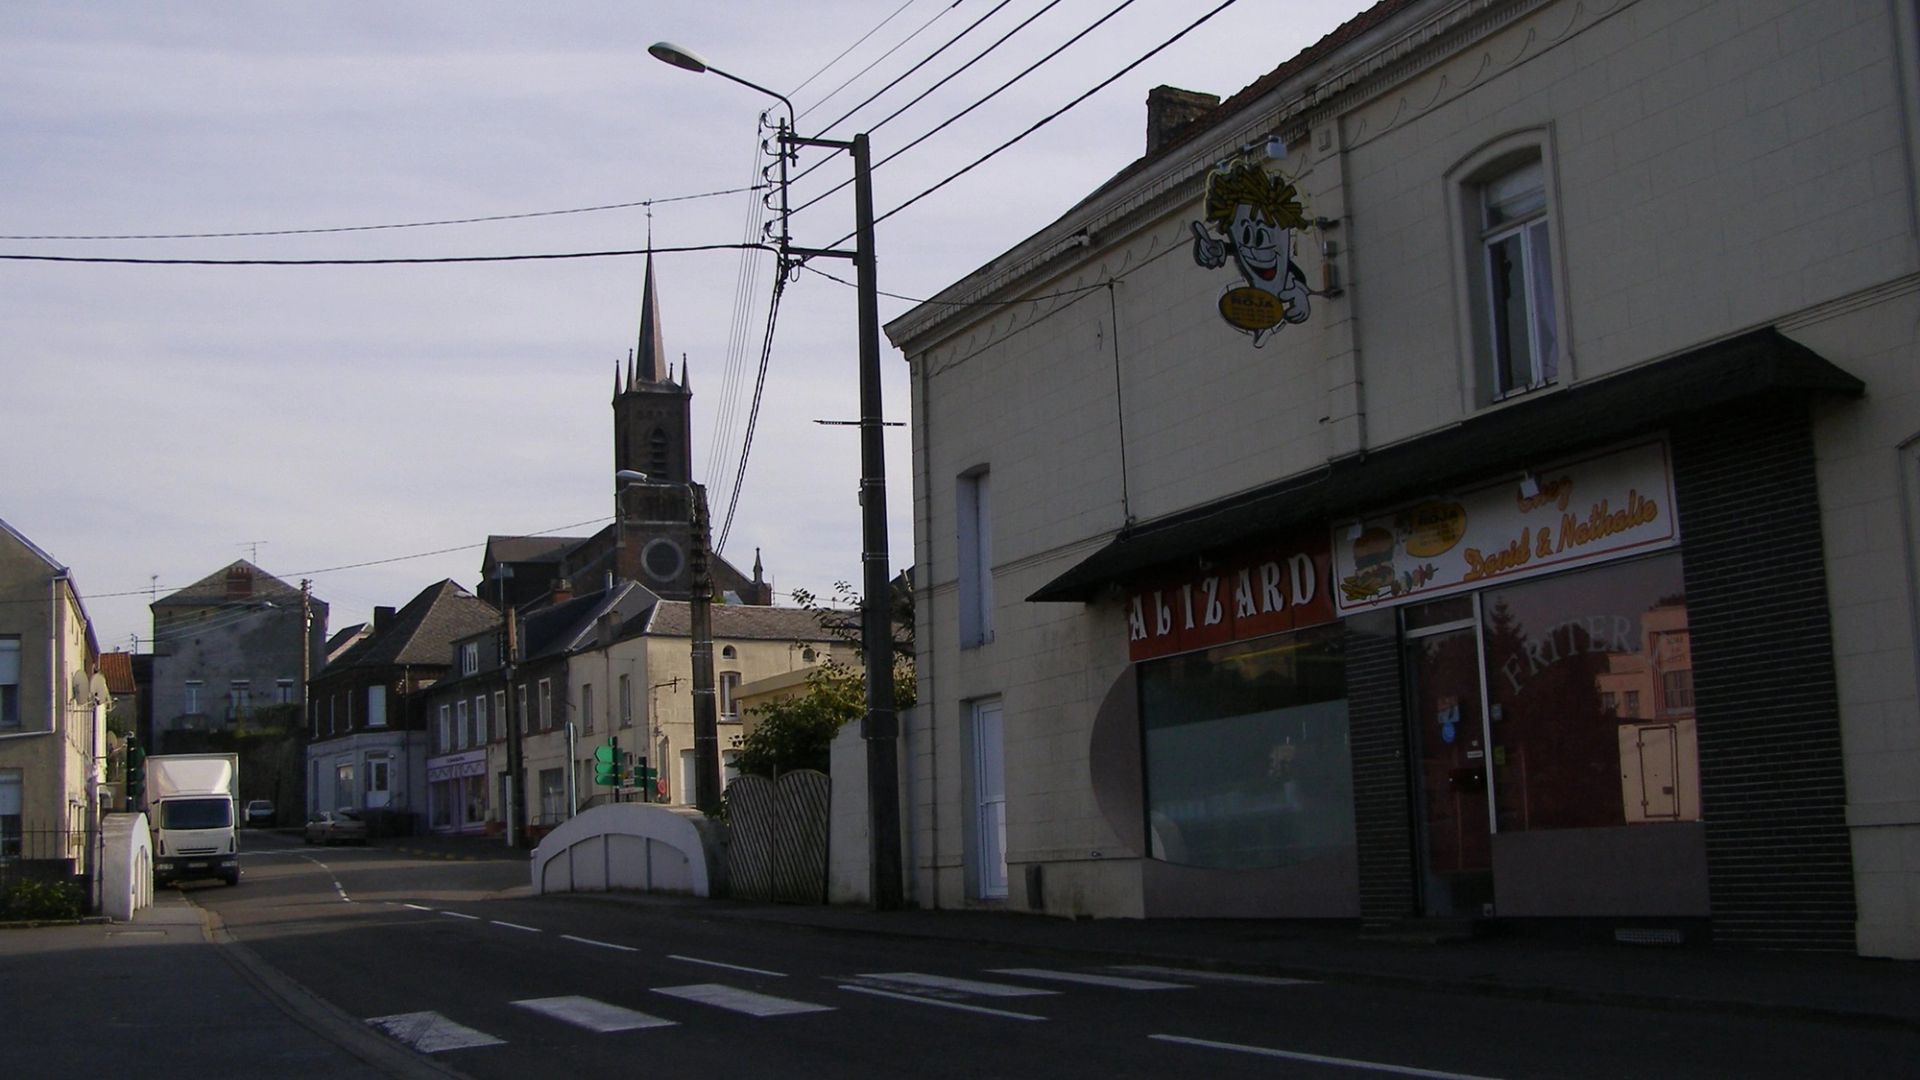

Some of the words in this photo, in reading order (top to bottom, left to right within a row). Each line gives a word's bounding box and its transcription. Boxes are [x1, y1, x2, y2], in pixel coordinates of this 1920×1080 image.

[1464, 527, 1530, 582] David
[1536, 527, 1554, 558] &
[1557, 489, 1658, 554] Nathalie
